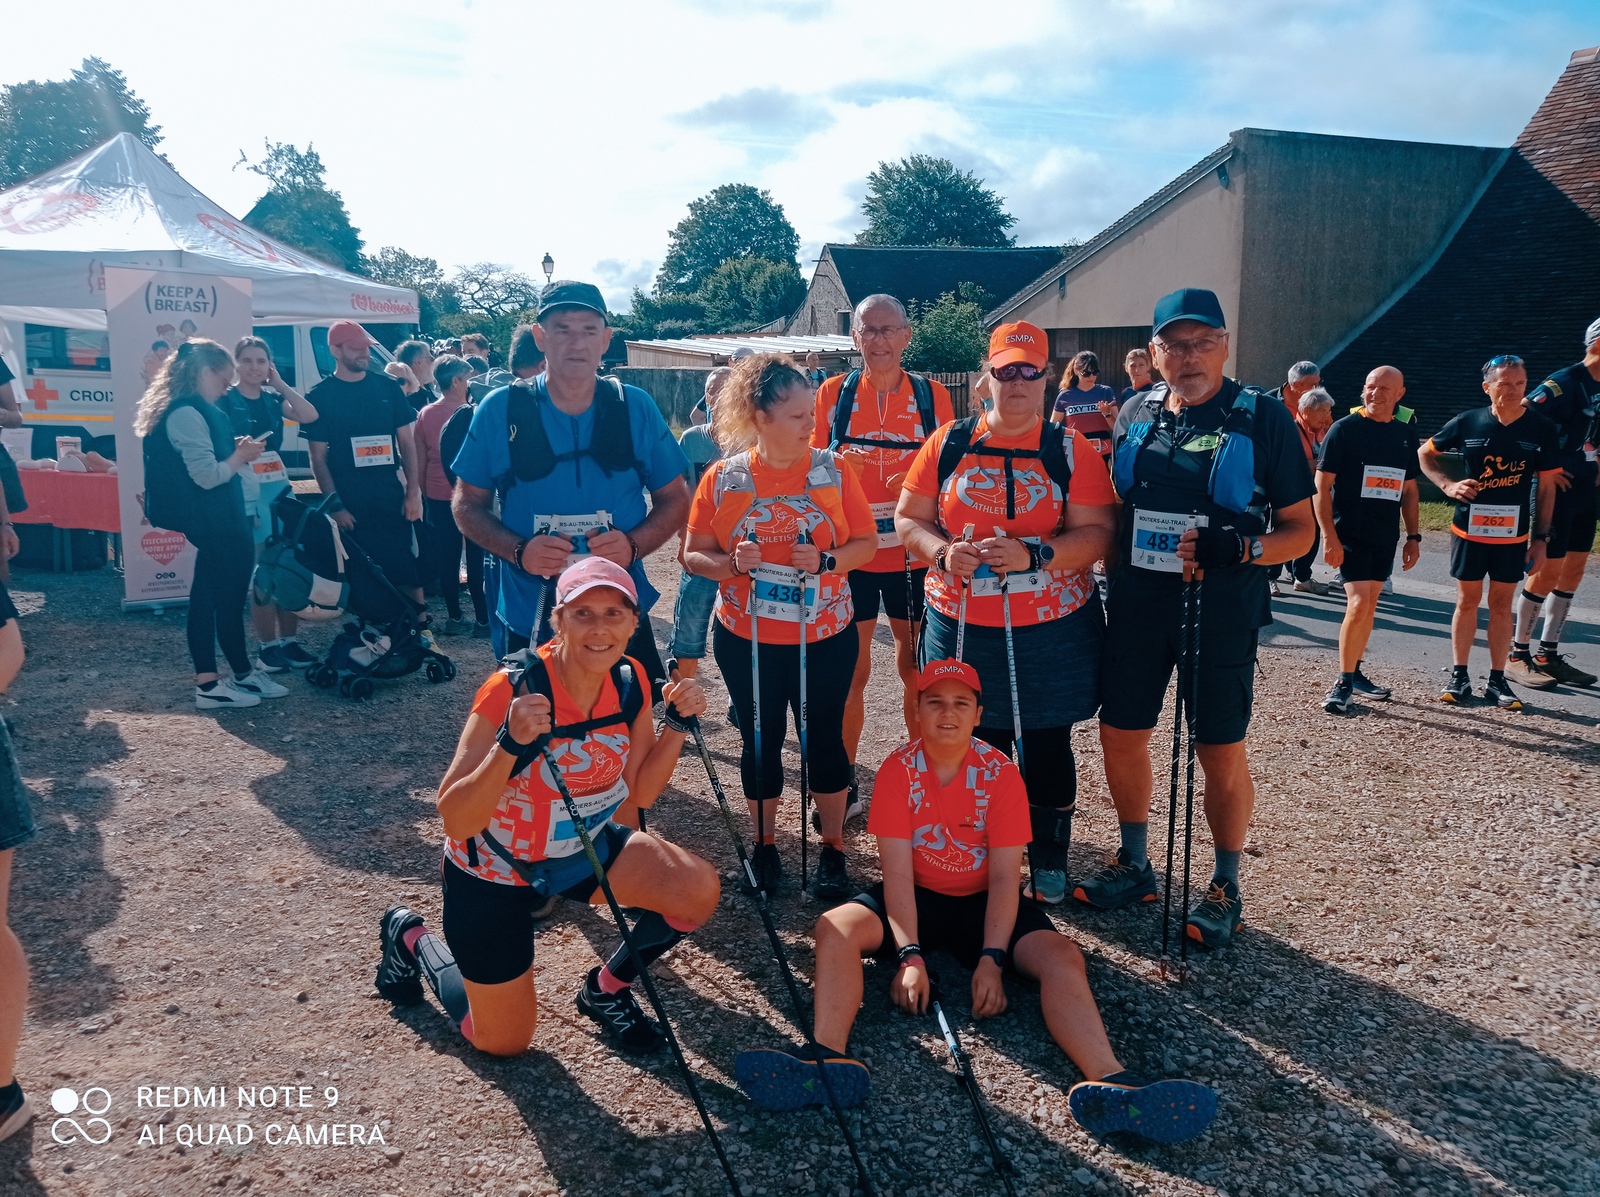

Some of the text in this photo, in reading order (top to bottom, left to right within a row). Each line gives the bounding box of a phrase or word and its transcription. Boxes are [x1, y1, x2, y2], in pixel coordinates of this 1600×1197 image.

[156, 285, 206, 300] KEEP A
[154, 299, 210, 314] BREAST
[1005, 334, 1035, 344] ESMPA
[365, 445, 383, 456] 289
[1375, 478, 1395, 489] 265
[971, 502, 1028, 515] ATHLETIME
[1139, 515, 1187, 526] MOUTIERS-AU-TRAIL
[1482, 516, 1505, 527] 262
[756, 533, 799, 543] THLETISM
[1146, 533, 1180, 551] 483
[758, 567, 800, 578] MOUTIERS-AU-TR
[767, 584, 801, 603] 436
[934, 665, 965, 675] ESMPA
